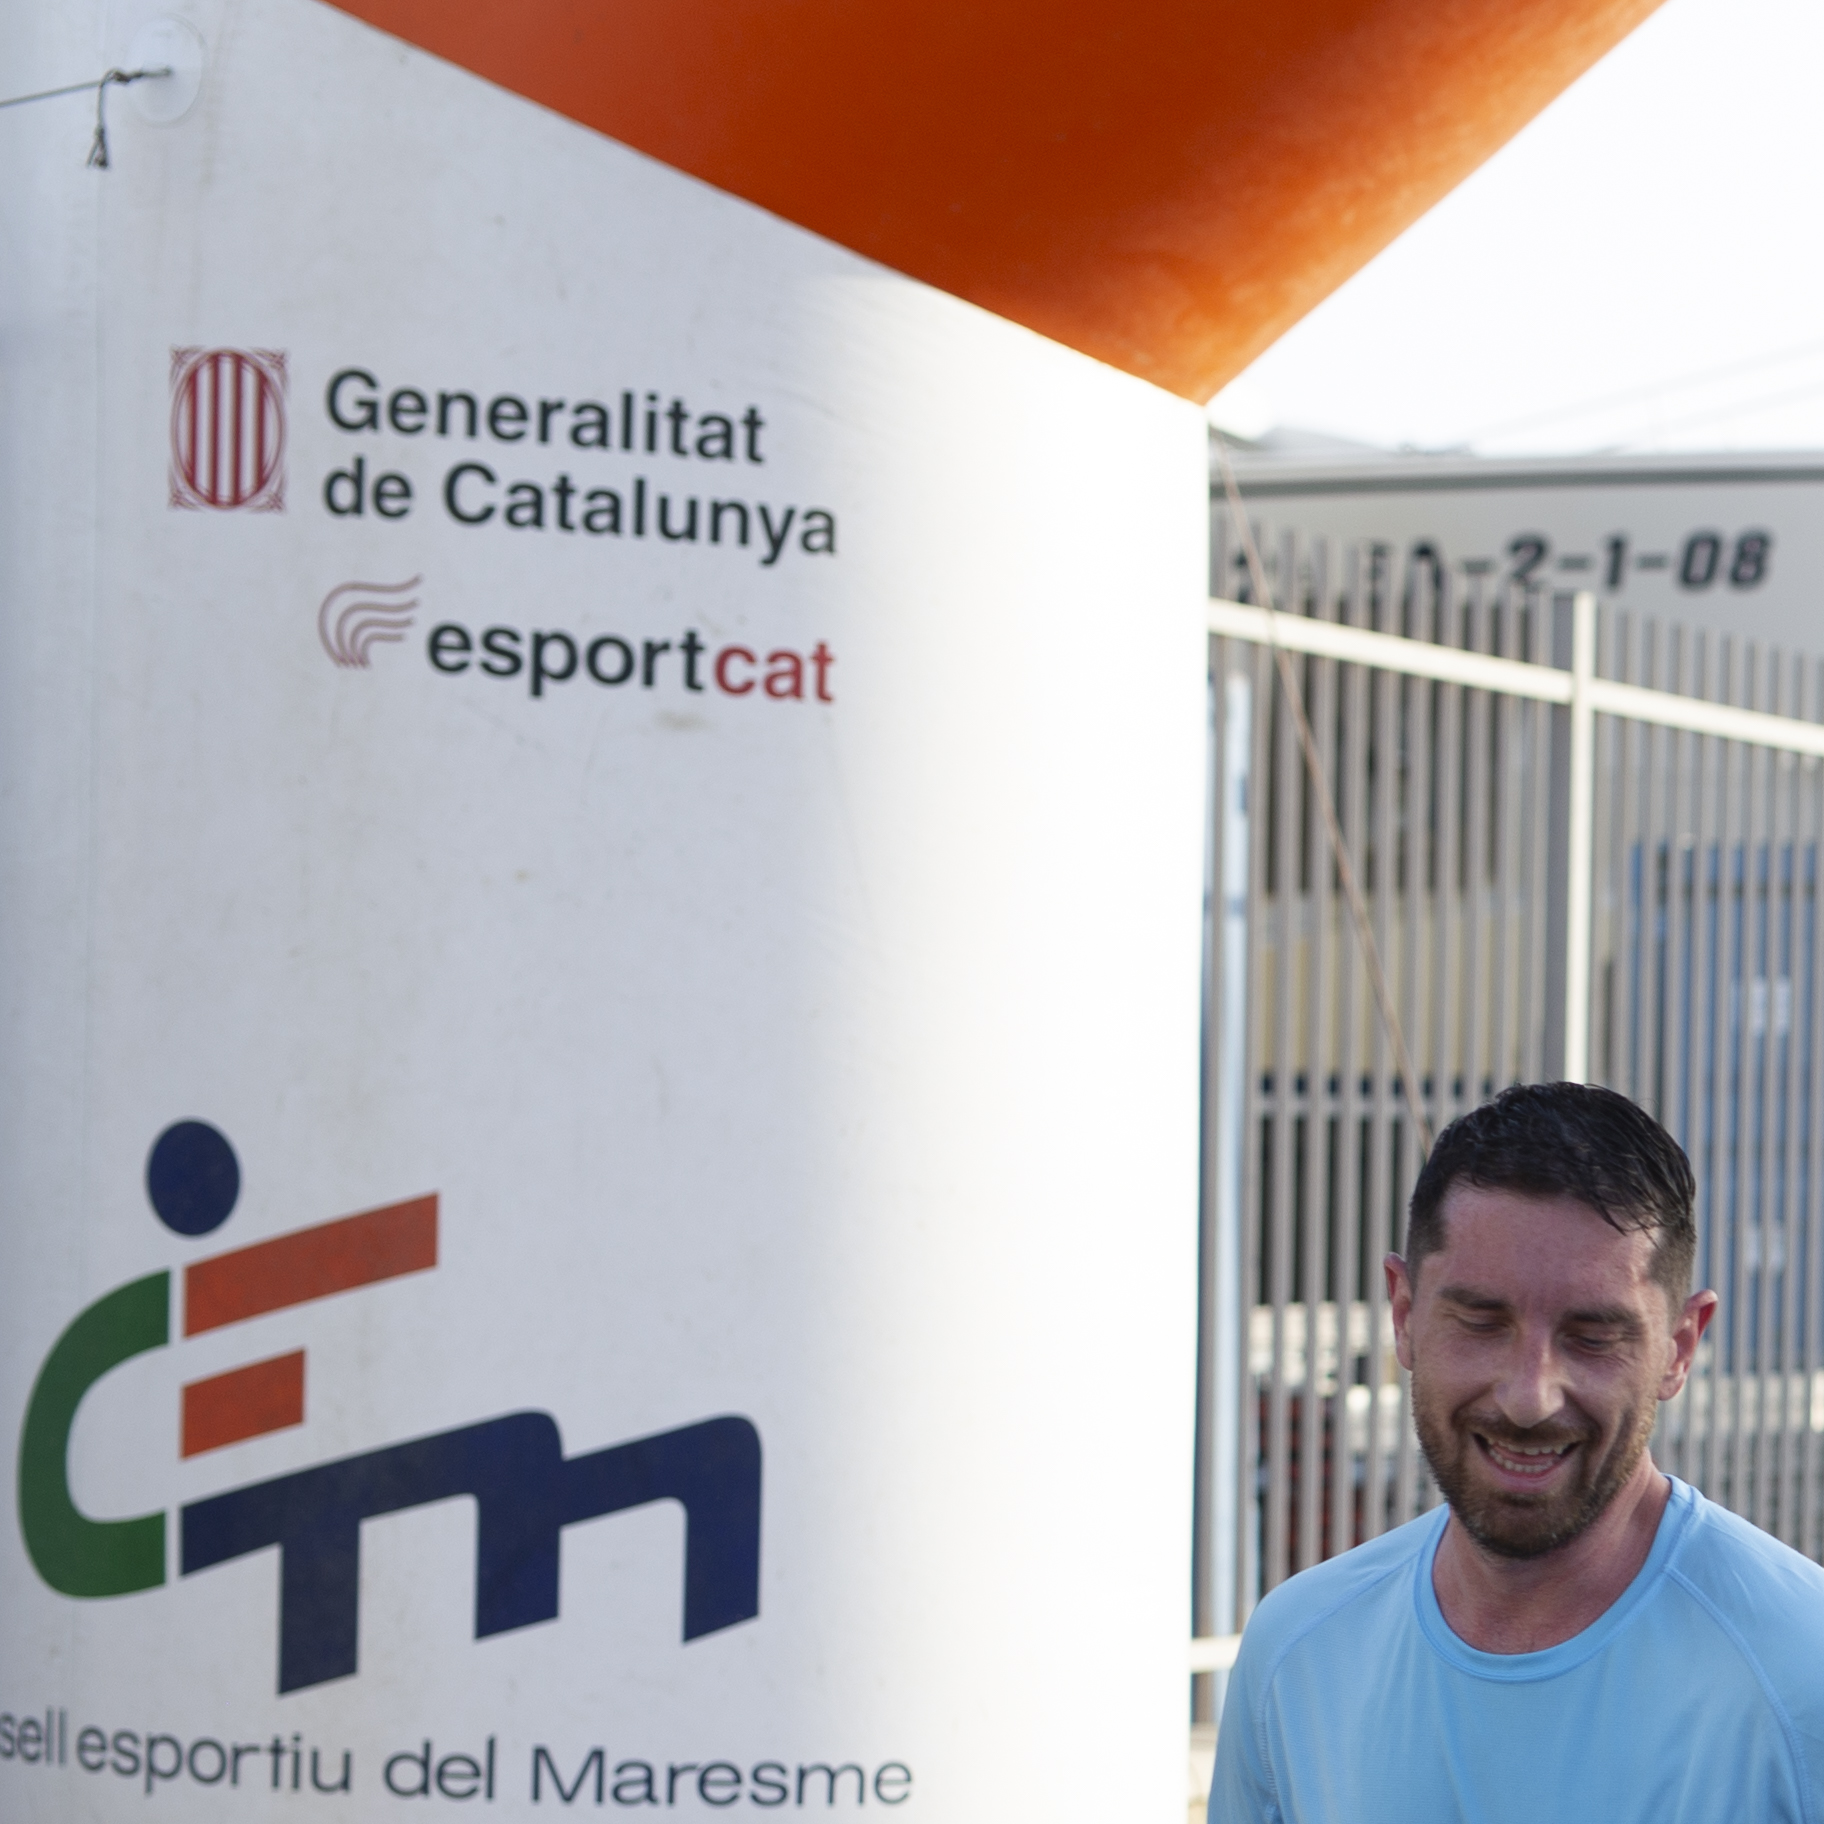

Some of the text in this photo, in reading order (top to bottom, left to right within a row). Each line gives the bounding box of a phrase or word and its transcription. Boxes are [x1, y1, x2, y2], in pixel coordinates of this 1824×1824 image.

[324, 368, 767, 465] Generalitat
[322, 456, 837, 566] de Catalunya
[425, 618, 835, 704] esportcat
[76, 1725, 352, 1798] esportiu
[384, 1735, 495, 1801] del
[531, 1745, 912, 1808] Maresme
